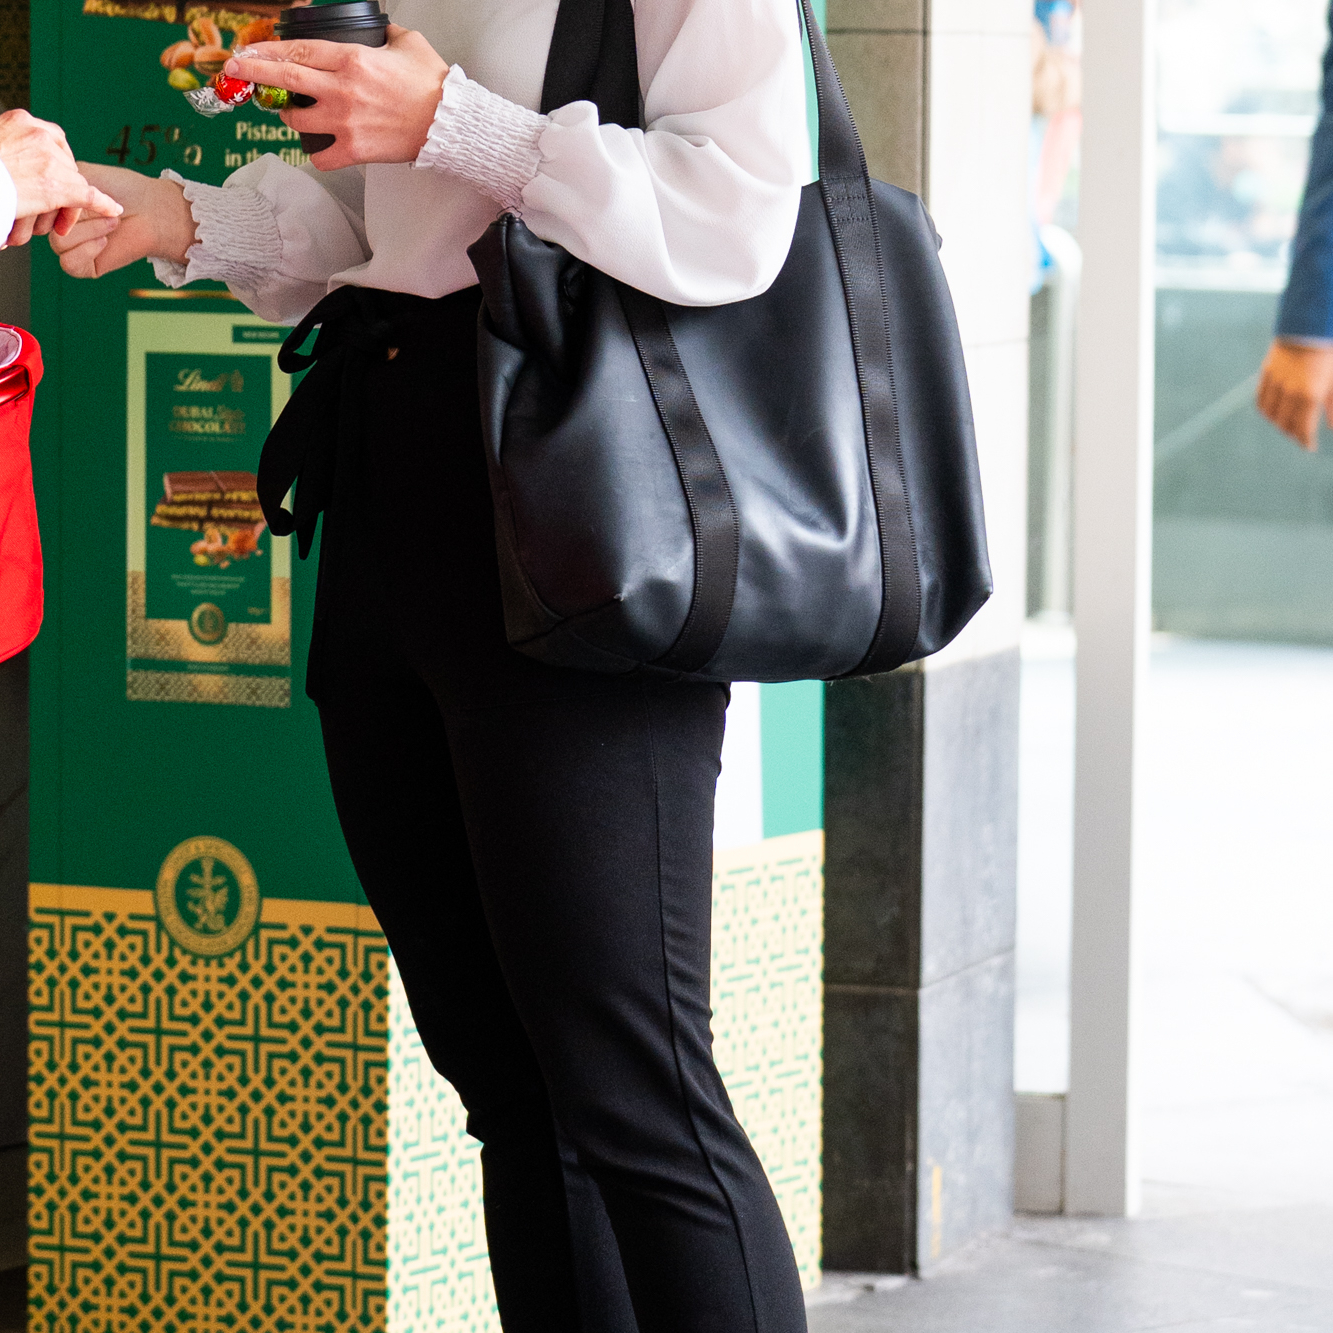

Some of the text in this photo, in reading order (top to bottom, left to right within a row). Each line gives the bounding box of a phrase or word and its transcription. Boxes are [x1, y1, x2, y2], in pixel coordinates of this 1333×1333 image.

[235, 121, 302, 141] Pistach
[225, 149, 243, 167] in
[246, 148, 263, 165] th
